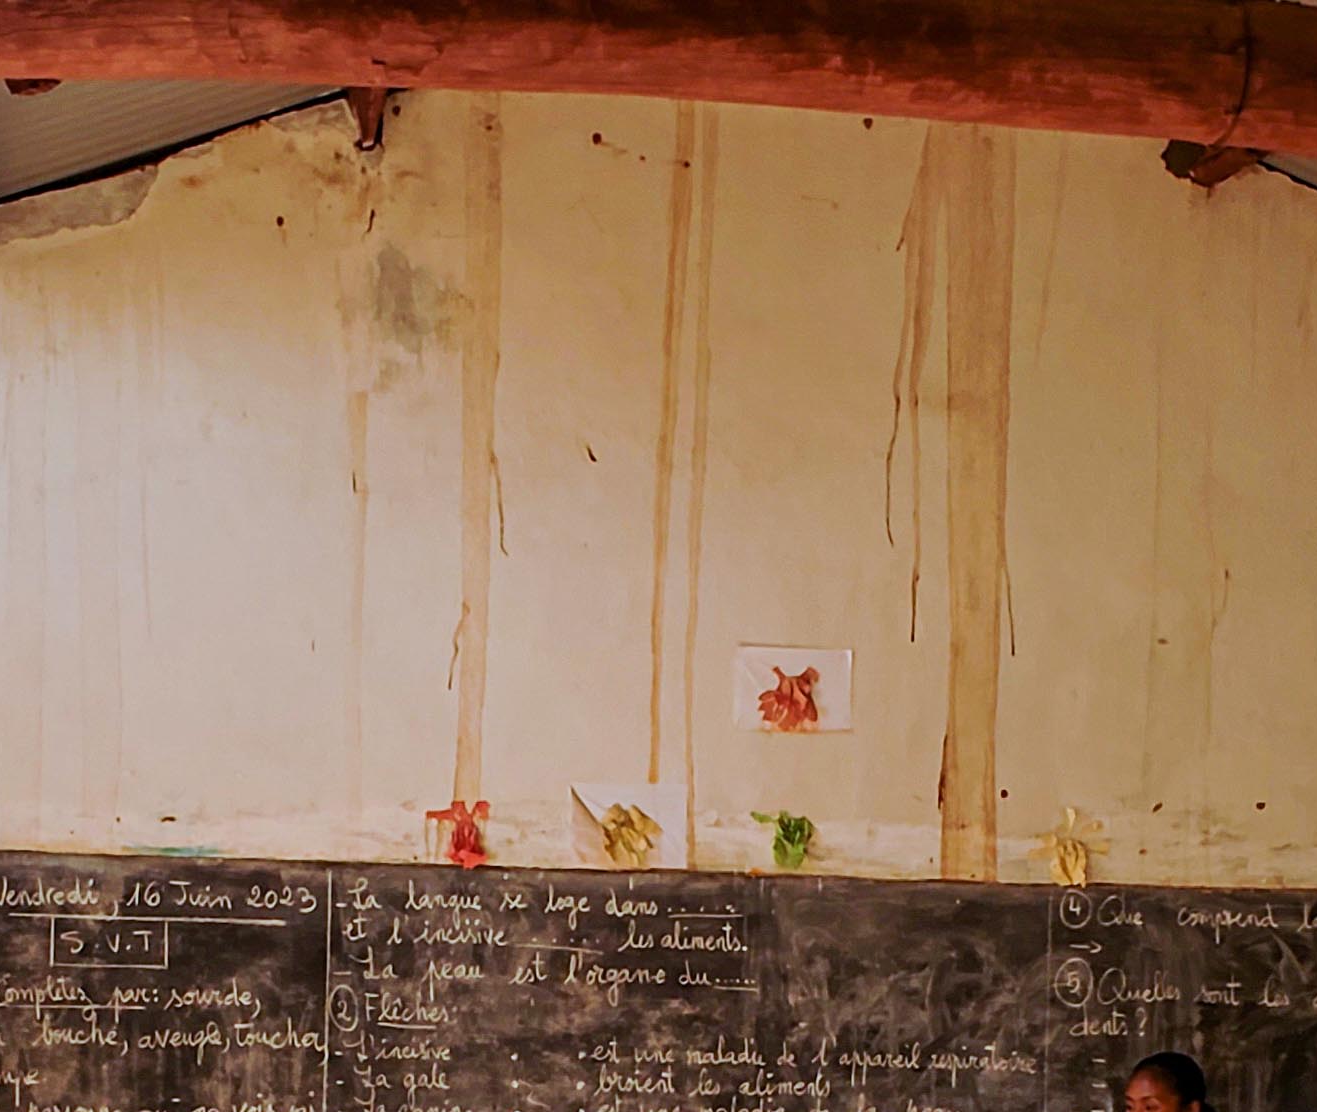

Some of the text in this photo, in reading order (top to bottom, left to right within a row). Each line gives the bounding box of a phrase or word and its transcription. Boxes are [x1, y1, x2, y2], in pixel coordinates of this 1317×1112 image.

[126, 882, 160, 909] 16
[169, 880, 232, 910] Juin
[247, 884, 317, 914] 2023
[405, 879, 482, 927] langue
[499, 892, 527, 909] se
[544, 884, 590, 931] loge
[604, 888, 659, 917] dans
[1098, 894, 1143, 926] Que
[342, 919, 367, 941] et
[618, 920, 654, 952] les
[421, 961, 485, 1002] peau
[509, 952, 549, 985] est
[564, 954, 666, 1007] l'organe
[1097, 967, 1181, 1005] Quelles
[1194, 975, 1242, 1006] sont
[1259, 974, 1290, 1008] les
[591, 1036, 620, 1064] est
[634, 1046, 674, 1064] une
[686, 1034, 767, 1065] maladie
[776, 1041, 797, 1067] de
[812, 1036, 921, 1087] l'appareil
[929, 1041, 1036, 1088] respiratoire
[403, 1063, 450, 1103] gale
[594, 1063, 675, 1096] broient
[688, 1067, 721, 1097] les
[738, 1068, 830, 1096] aliments
